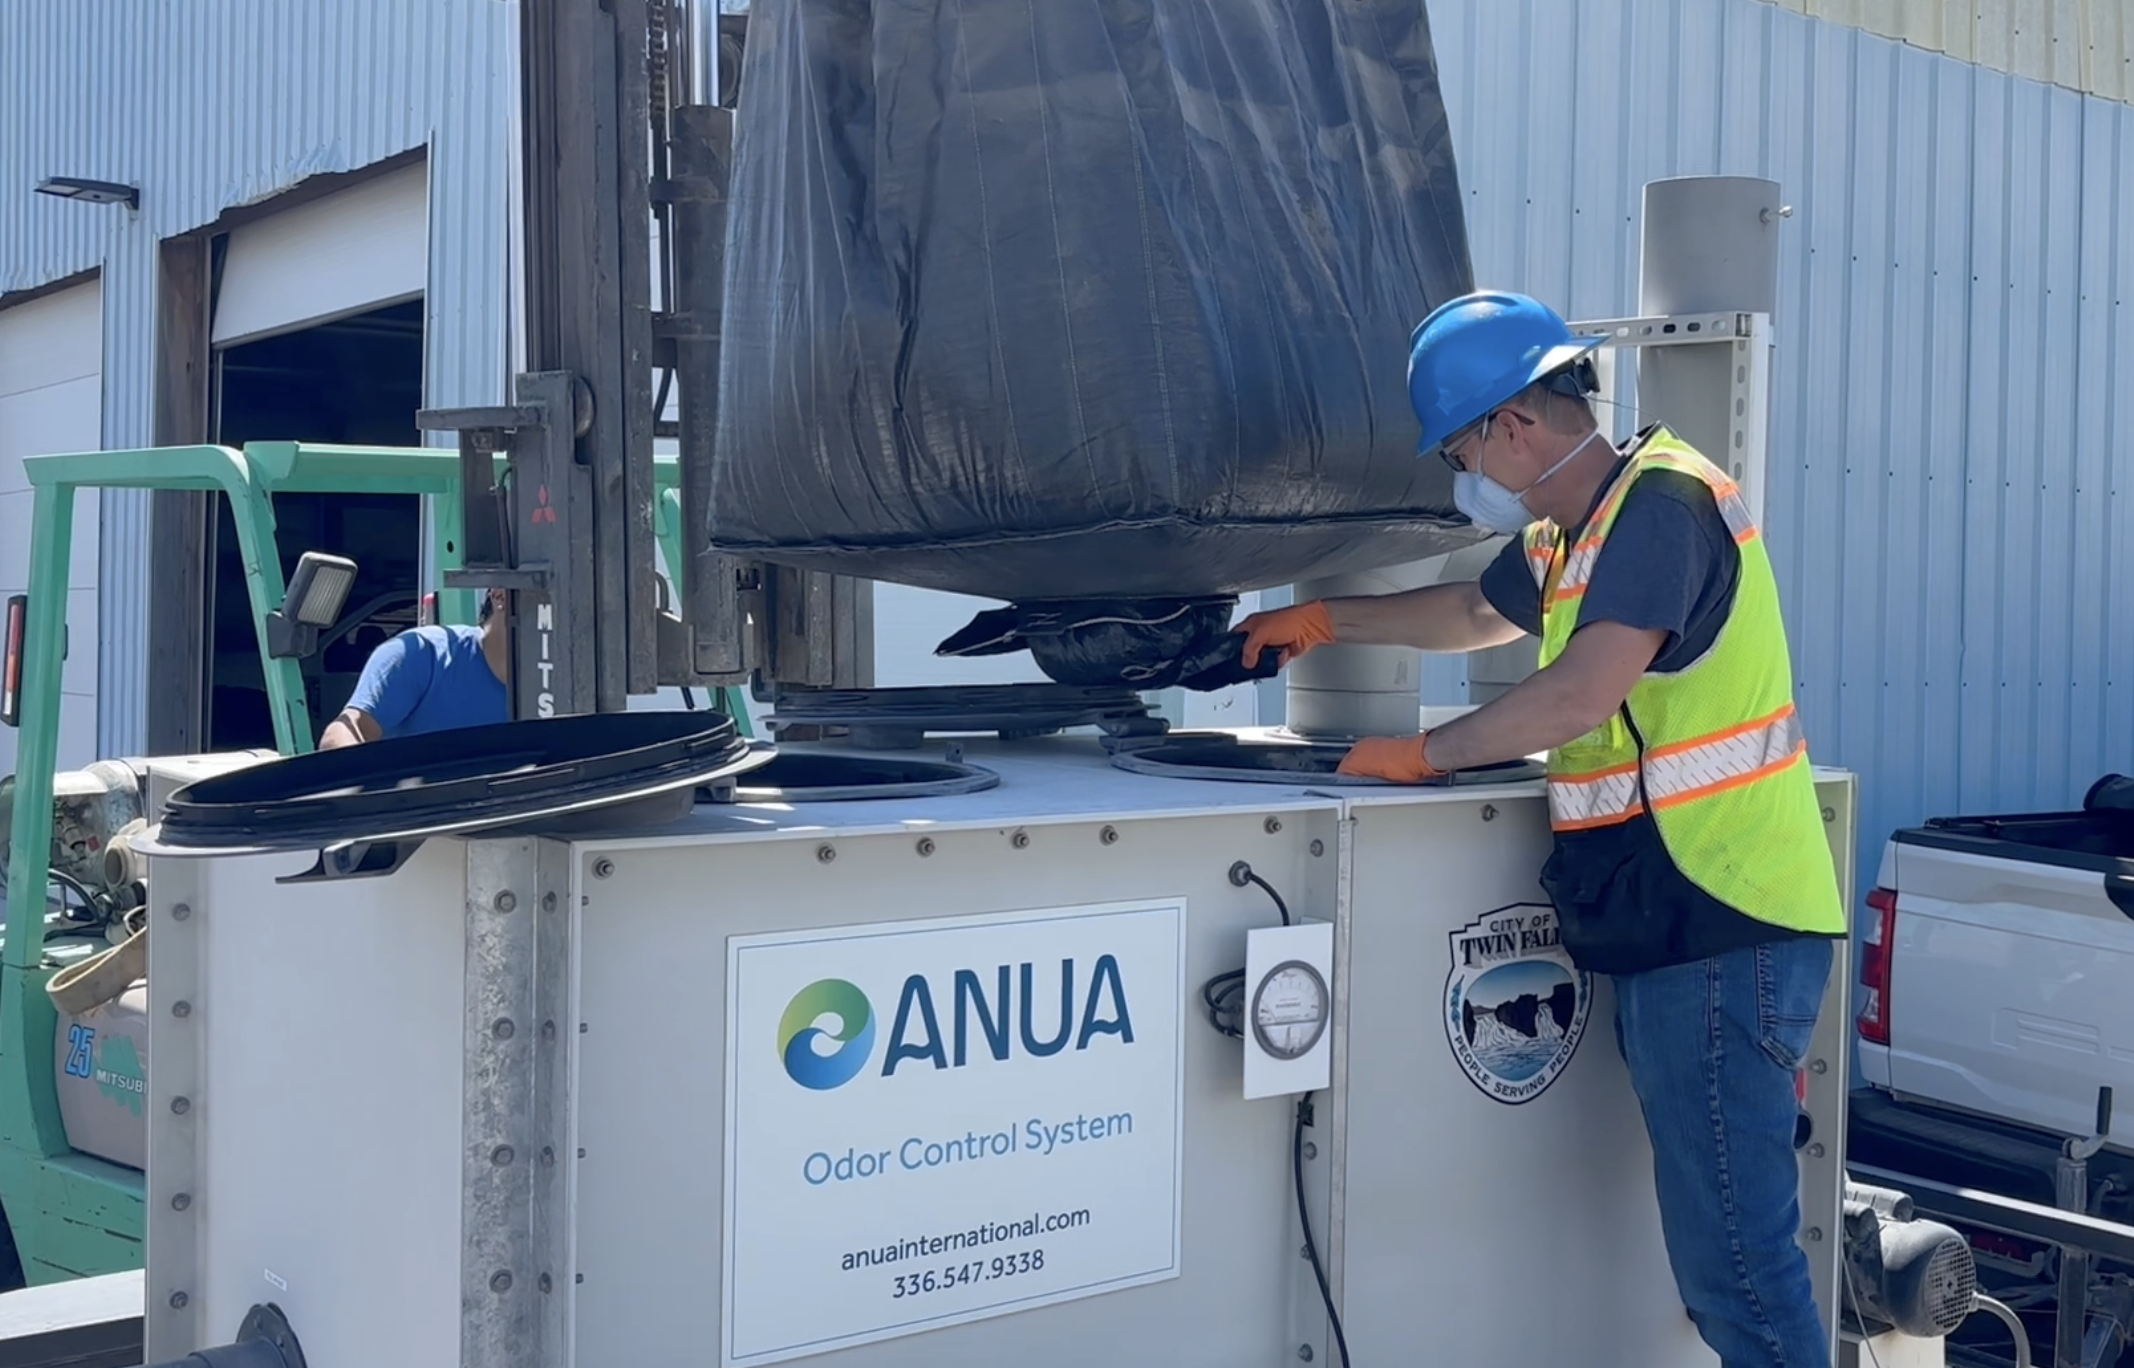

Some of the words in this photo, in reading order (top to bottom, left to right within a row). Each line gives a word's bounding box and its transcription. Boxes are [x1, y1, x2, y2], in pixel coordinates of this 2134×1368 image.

[1460, 932, 1516, 966] TWIN
[1490, 917, 1524, 933] CITY
[1531, 914, 1550, 927] OF
[881, 954, 1134, 1076] ANUA
[65, 1023, 95, 1079] 25
[1455, 1036, 1489, 1085] PEOPLE
[1494, 1074, 1546, 1097] SERVING
[1550, 1016, 1582, 1073] PEOPLE
[803, 1148, 891, 1185] Odor
[899, 1122, 1017, 1170] Control
[1025, 1111, 1133, 1155] System
[841, 1207, 1090, 1271] anuainternational.com
[892, 1249, 1045, 1299] 336.547.9338
